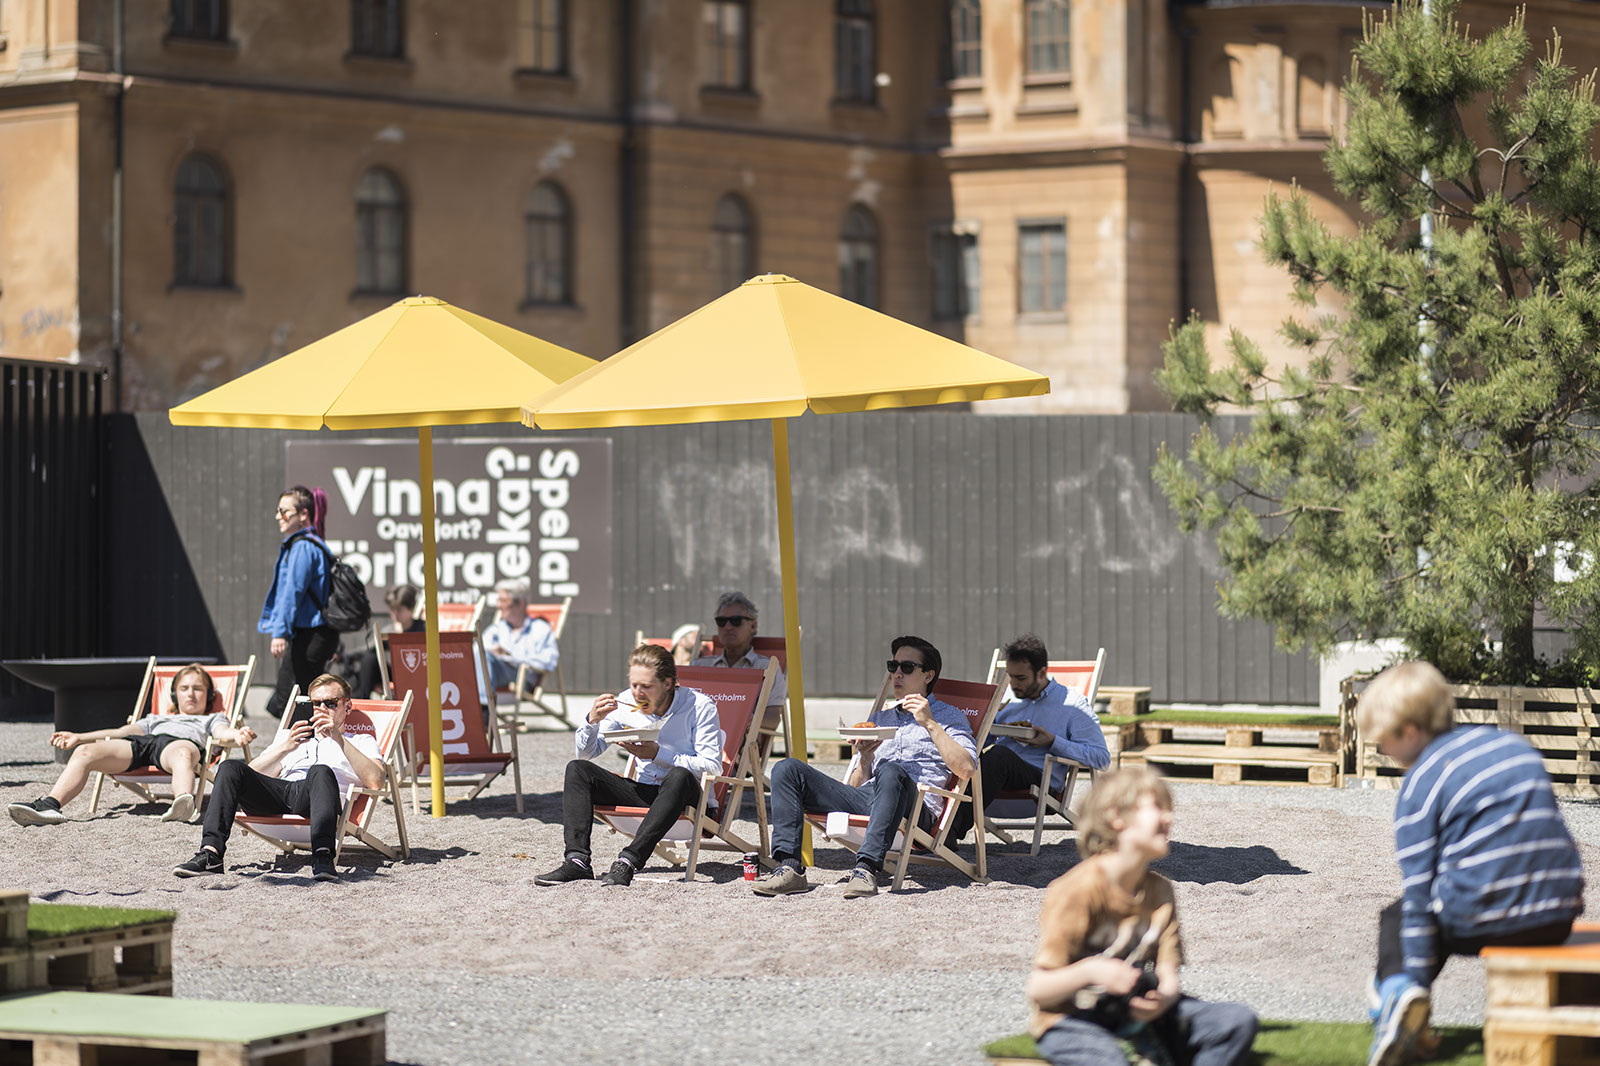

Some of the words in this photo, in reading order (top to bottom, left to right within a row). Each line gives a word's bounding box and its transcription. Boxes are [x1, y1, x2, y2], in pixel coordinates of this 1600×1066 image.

[333, 467, 490, 515] Vinna
[376, 518, 482, 544] Oavjort?
[486, 447, 531, 607] eka?
[531, 448, 580, 596] Spela!
[326, 540, 495, 587] örlora
